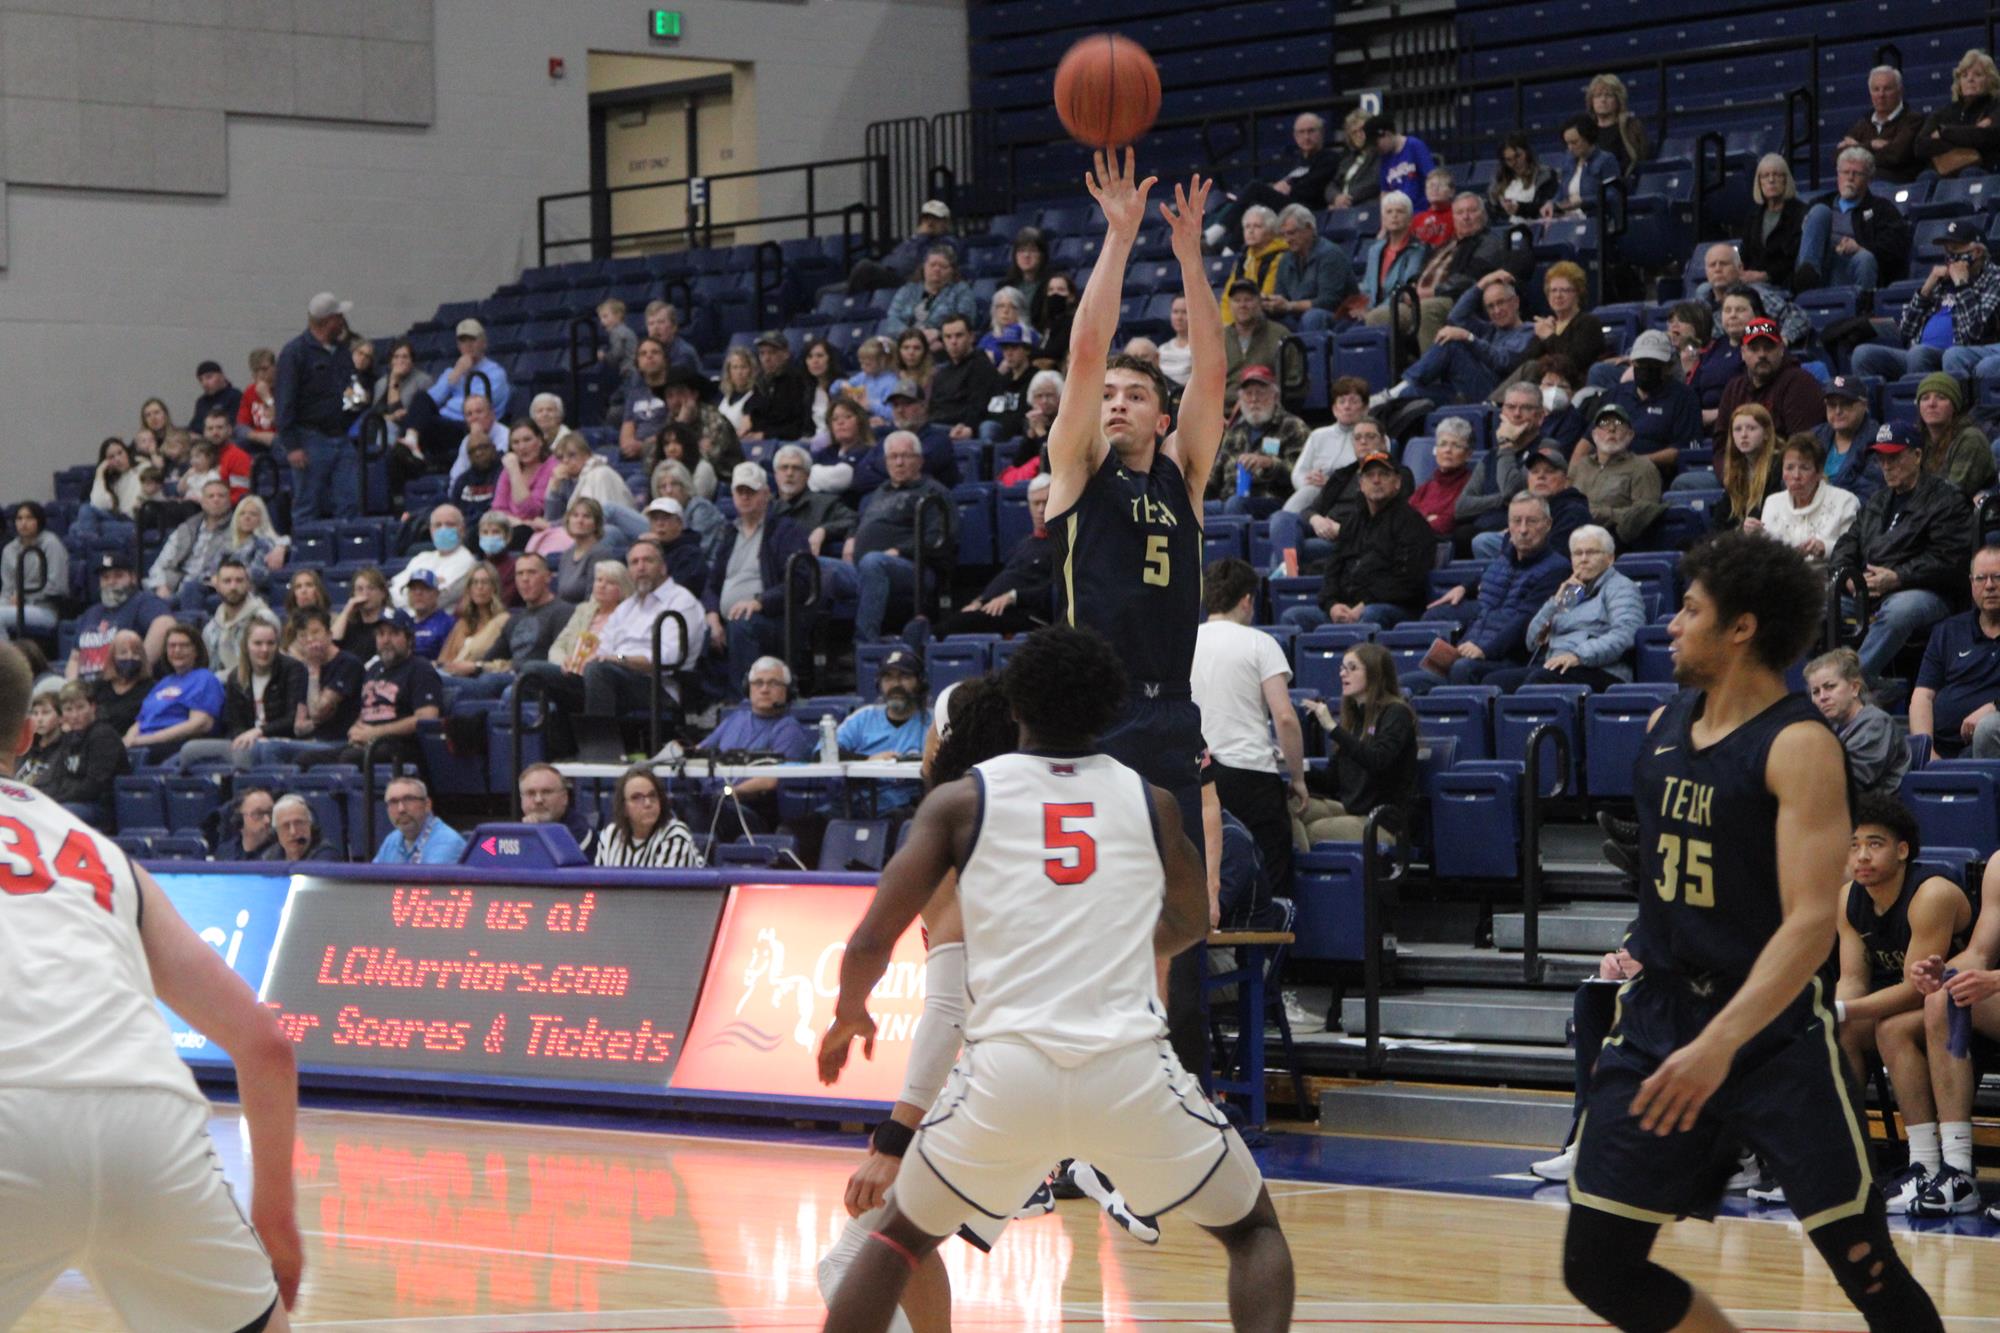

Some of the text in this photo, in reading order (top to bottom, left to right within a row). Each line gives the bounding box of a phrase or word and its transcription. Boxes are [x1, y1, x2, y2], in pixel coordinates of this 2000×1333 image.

[691, 178, 705, 204] E
[1143, 534, 1170, 587] 5
[0, 814, 114, 914] 34
[498, 838, 520, 855] POSS
[1042, 801, 1097, 886] 5
[1654, 833, 1715, 908] 35
[392, 888, 596, 932] Visit us at
[317, 945, 630, 997] LCWarriors.com
[332, 1005, 472, 1051] Scores
[526, 1014, 675, 1063] Tickets
